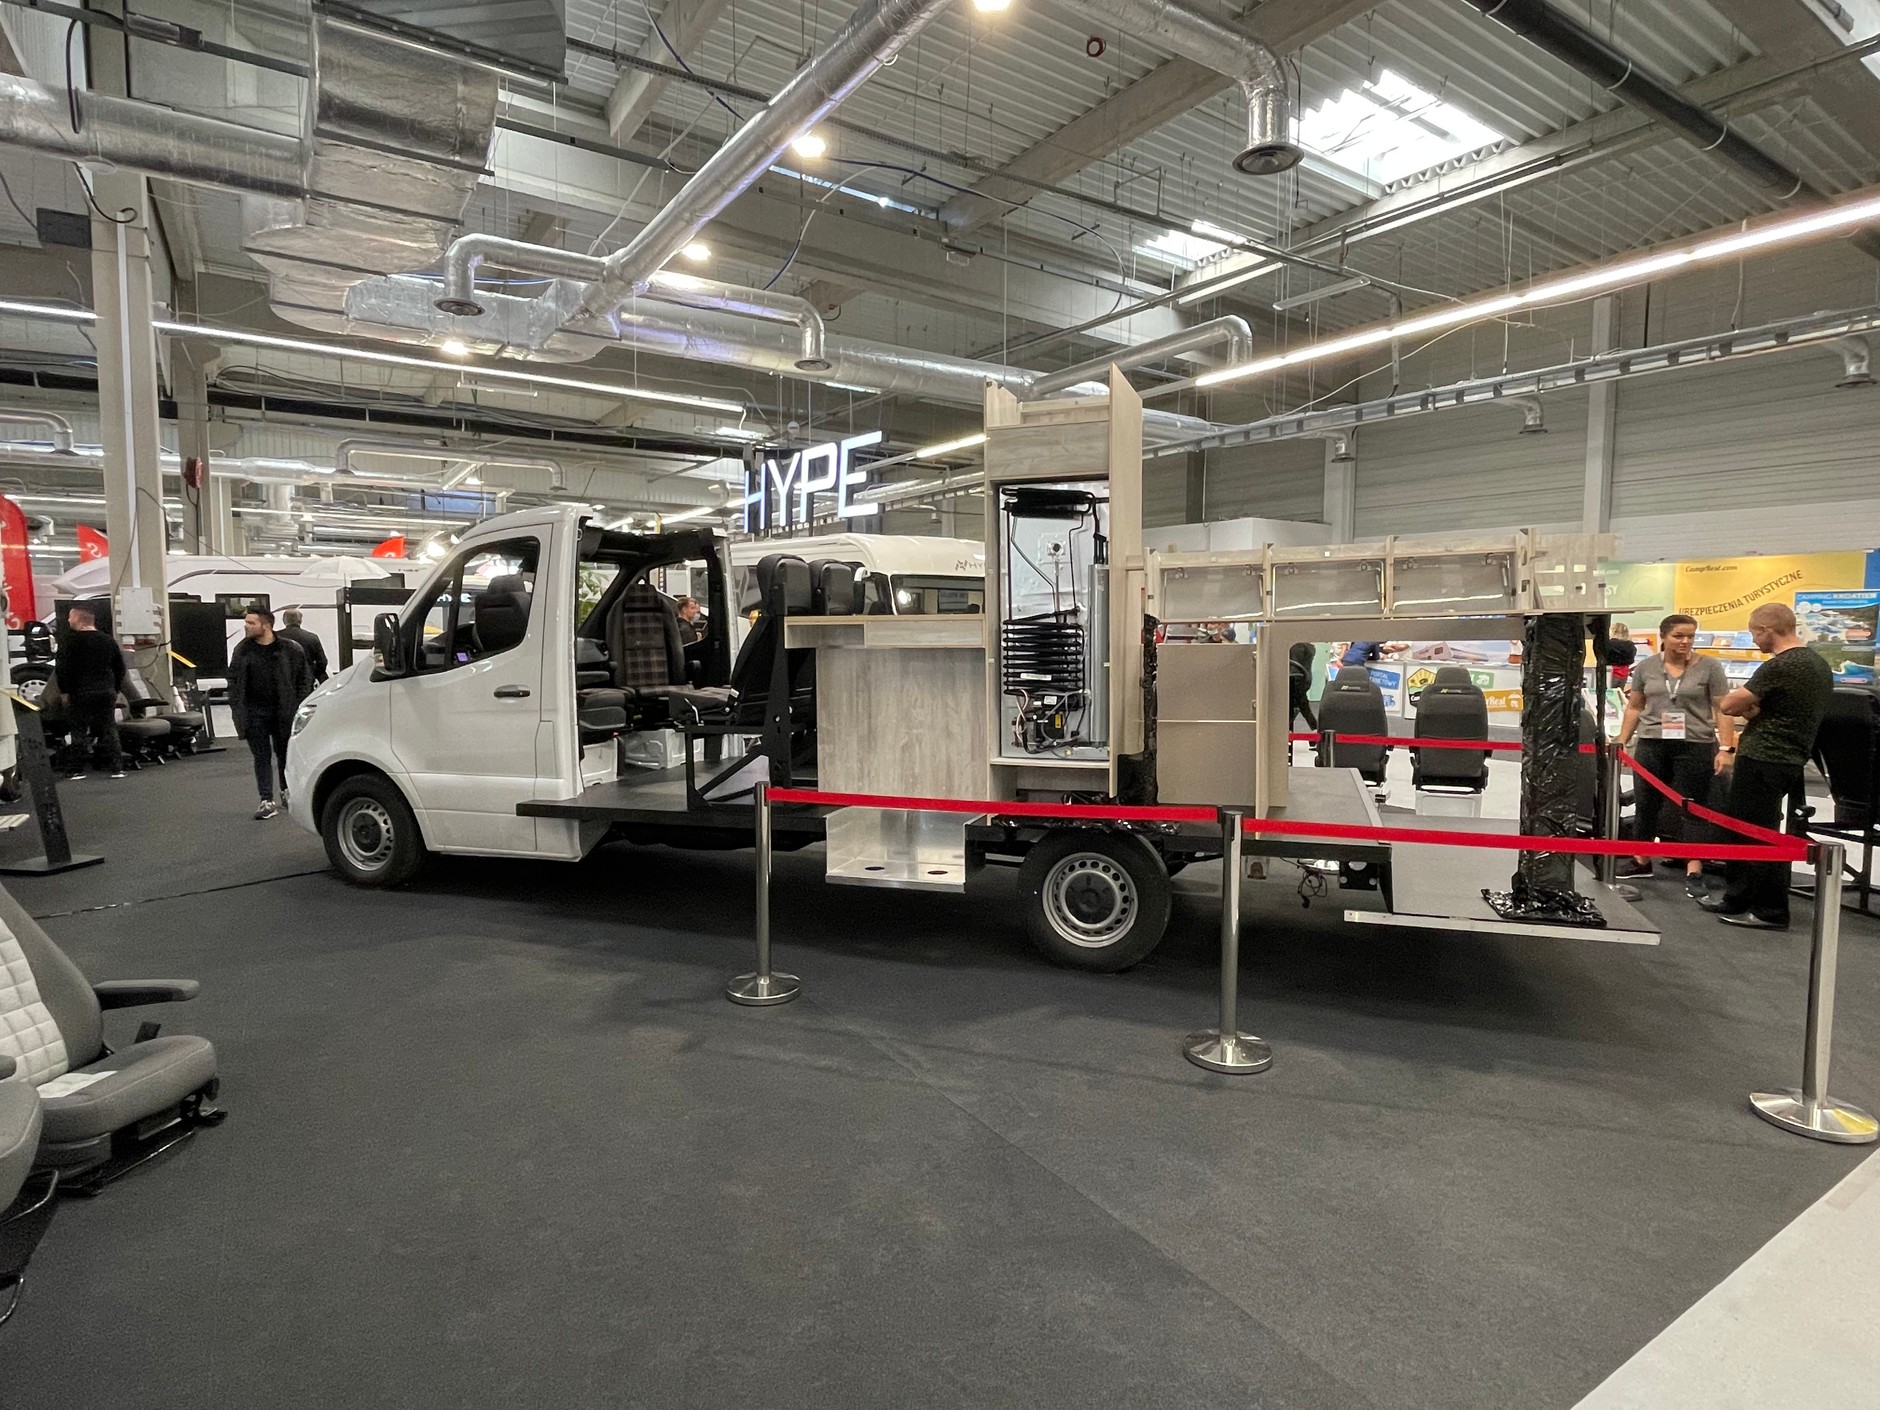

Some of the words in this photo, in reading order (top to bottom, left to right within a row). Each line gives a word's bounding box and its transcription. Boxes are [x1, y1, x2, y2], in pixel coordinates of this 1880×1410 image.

[743, 430, 882, 534] HYPE
[1679, 598, 1744, 616] UBEZPIECZENIA
[1742, 569, 1803, 604] TURYSTYCZNE
